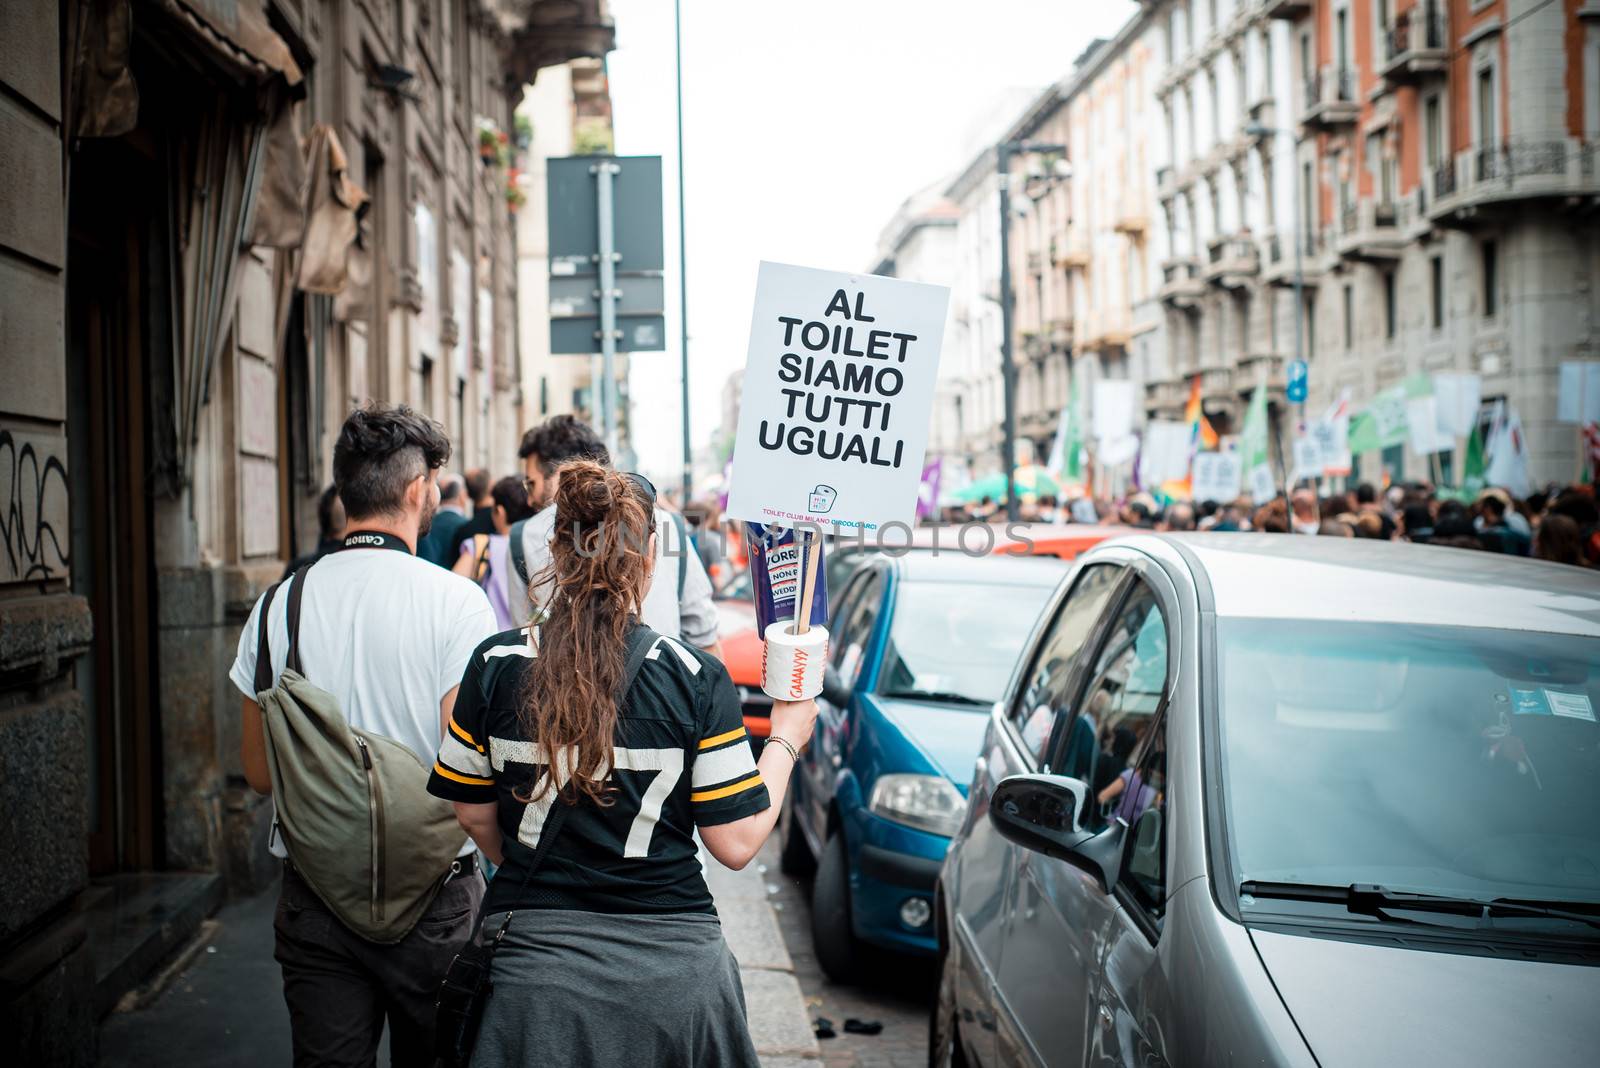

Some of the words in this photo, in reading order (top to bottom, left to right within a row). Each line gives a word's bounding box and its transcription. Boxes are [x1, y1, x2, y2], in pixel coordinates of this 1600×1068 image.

[824, 288, 876, 323] AL
[778, 316, 918, 363] TOILET
[778, 353, 904, 397] SIAMO
[781, 388, 891, 431] TUTTI
[758, 420, 904, 468] UGUALI
[763, 508, 786, 518] TOILET
[786, 513, 803, 521] CLUB
[804, 516, 830, 525] MILANO
[345, 535, 385, 547] Canon
[488, 736, 684, 858] 77
